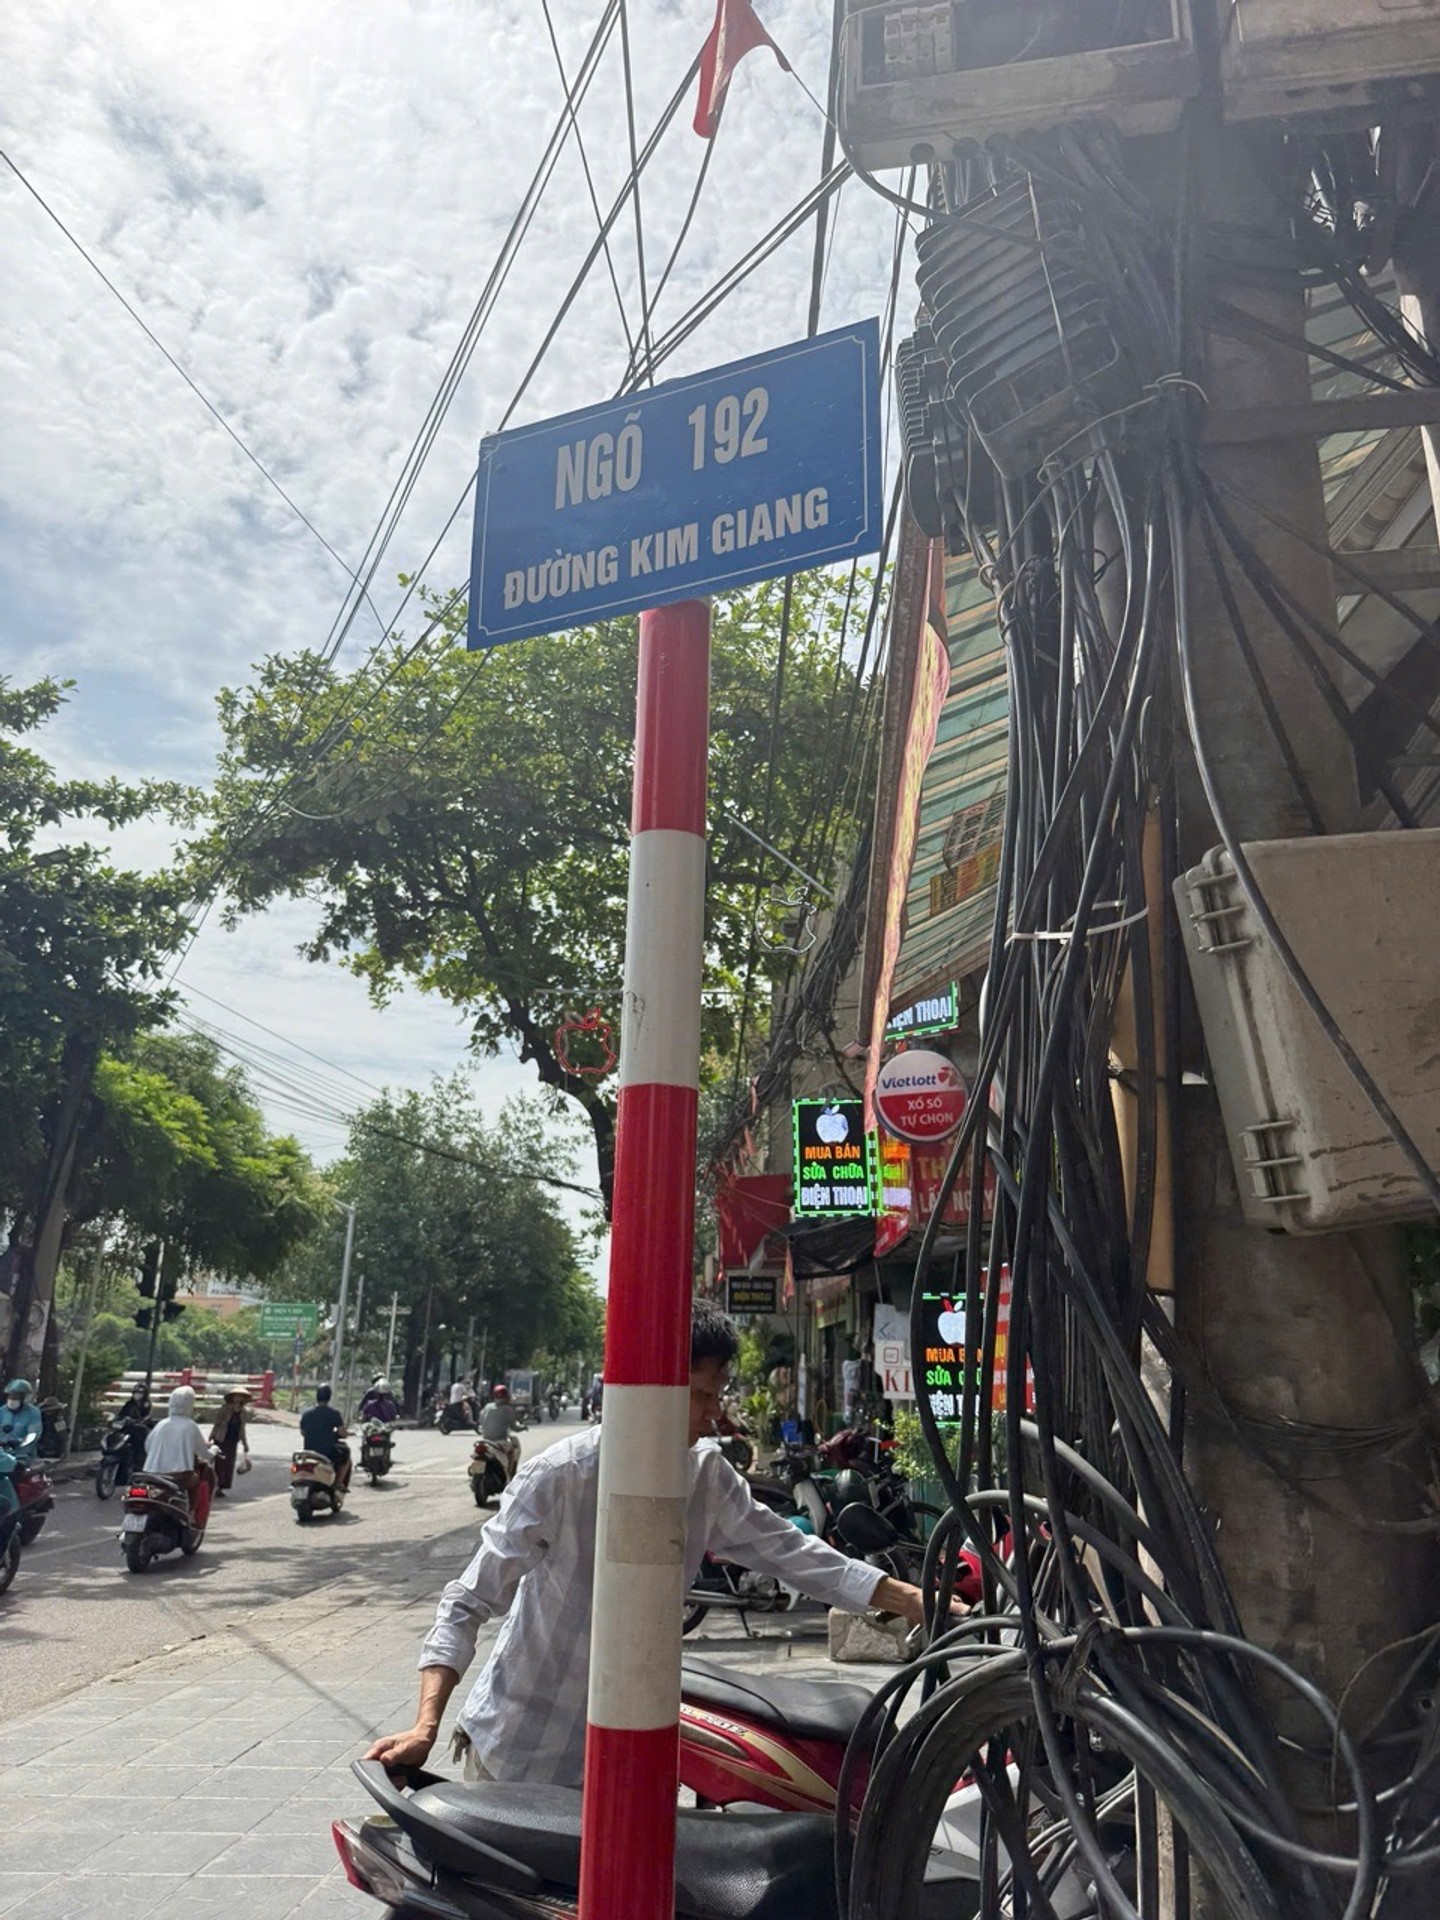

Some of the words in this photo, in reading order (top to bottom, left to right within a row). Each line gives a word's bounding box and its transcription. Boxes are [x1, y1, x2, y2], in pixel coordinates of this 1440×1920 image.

[554, 410, 644, 510] NGÕ
[688, 387, 770, 471] 192
[503, 545, 618, 610] ĐƯỜNG
[630, 522, 698, 577] KIM
[711, 487, 829, 555] GIANG
[882, 1074, 936, 1089] Vietlott
[920, 1112, 953, 1126] CHỌN
[805, 1146, 832, 1159] MUA
[835, 1143, 860, 1159] BÁN
[832, 1163, 864, 1179] CHỮA
[801, 1183, 830, 1209] ĐIỆN
[832, 1186, 867, 1208] THOẠI
[926, 1348, 955, 1362] MUA
